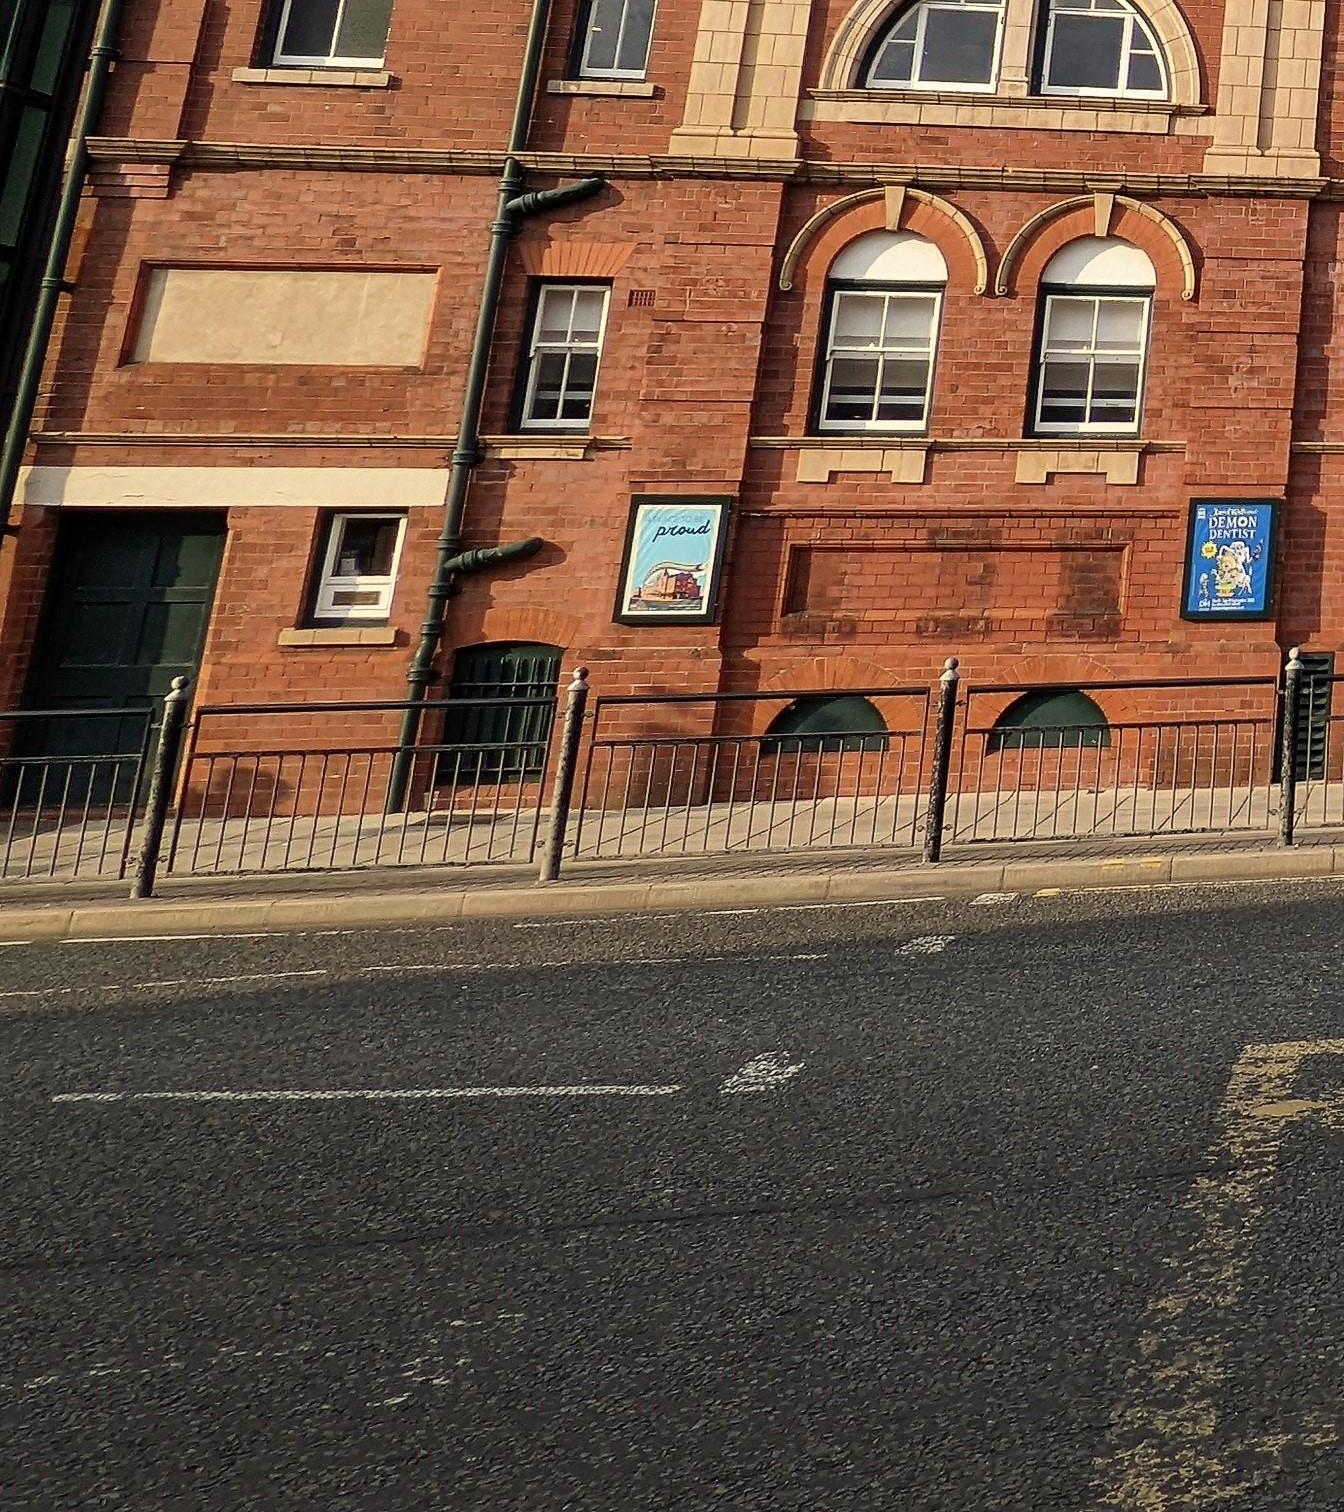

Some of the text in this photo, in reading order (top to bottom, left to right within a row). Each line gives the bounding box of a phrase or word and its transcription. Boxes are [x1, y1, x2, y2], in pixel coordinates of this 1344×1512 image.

[1209, 516, 1258, 529] DEMON
[652, 520, 711, 543] proud
[1209, 528, 1257, 540] DENTIST
